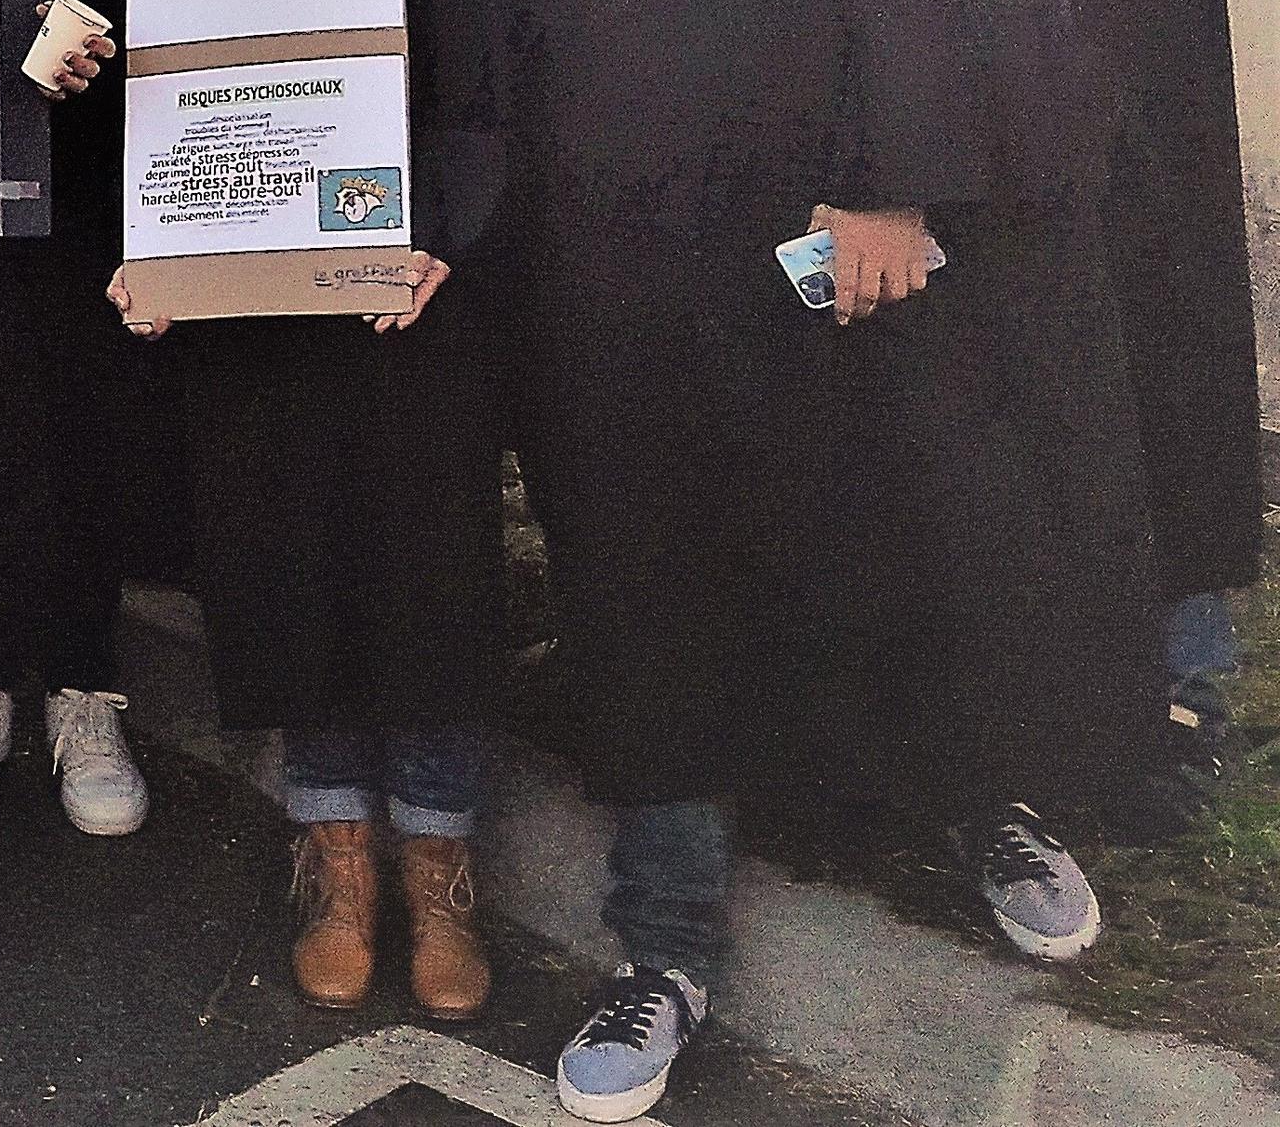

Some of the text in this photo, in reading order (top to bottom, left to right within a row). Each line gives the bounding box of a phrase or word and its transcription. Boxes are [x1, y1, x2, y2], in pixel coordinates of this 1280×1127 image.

[178, 79, 342, 108] RISQUES PSYCHOSOCIAUX
[151, 148, 300, 169] anxiété stress dépression
[172, 144, 210, 156] fatigue
[181, 177, 229, 192] stress
[233, 175, 254, 187] au
[260, 166, 315, 186] travail
[192, 160, 264, 177] burn-out
[141, 189, 226, 207] harcèlement
[230, 183, 302, 200] bore-out
[160, 210, 224, 225] épuisement
